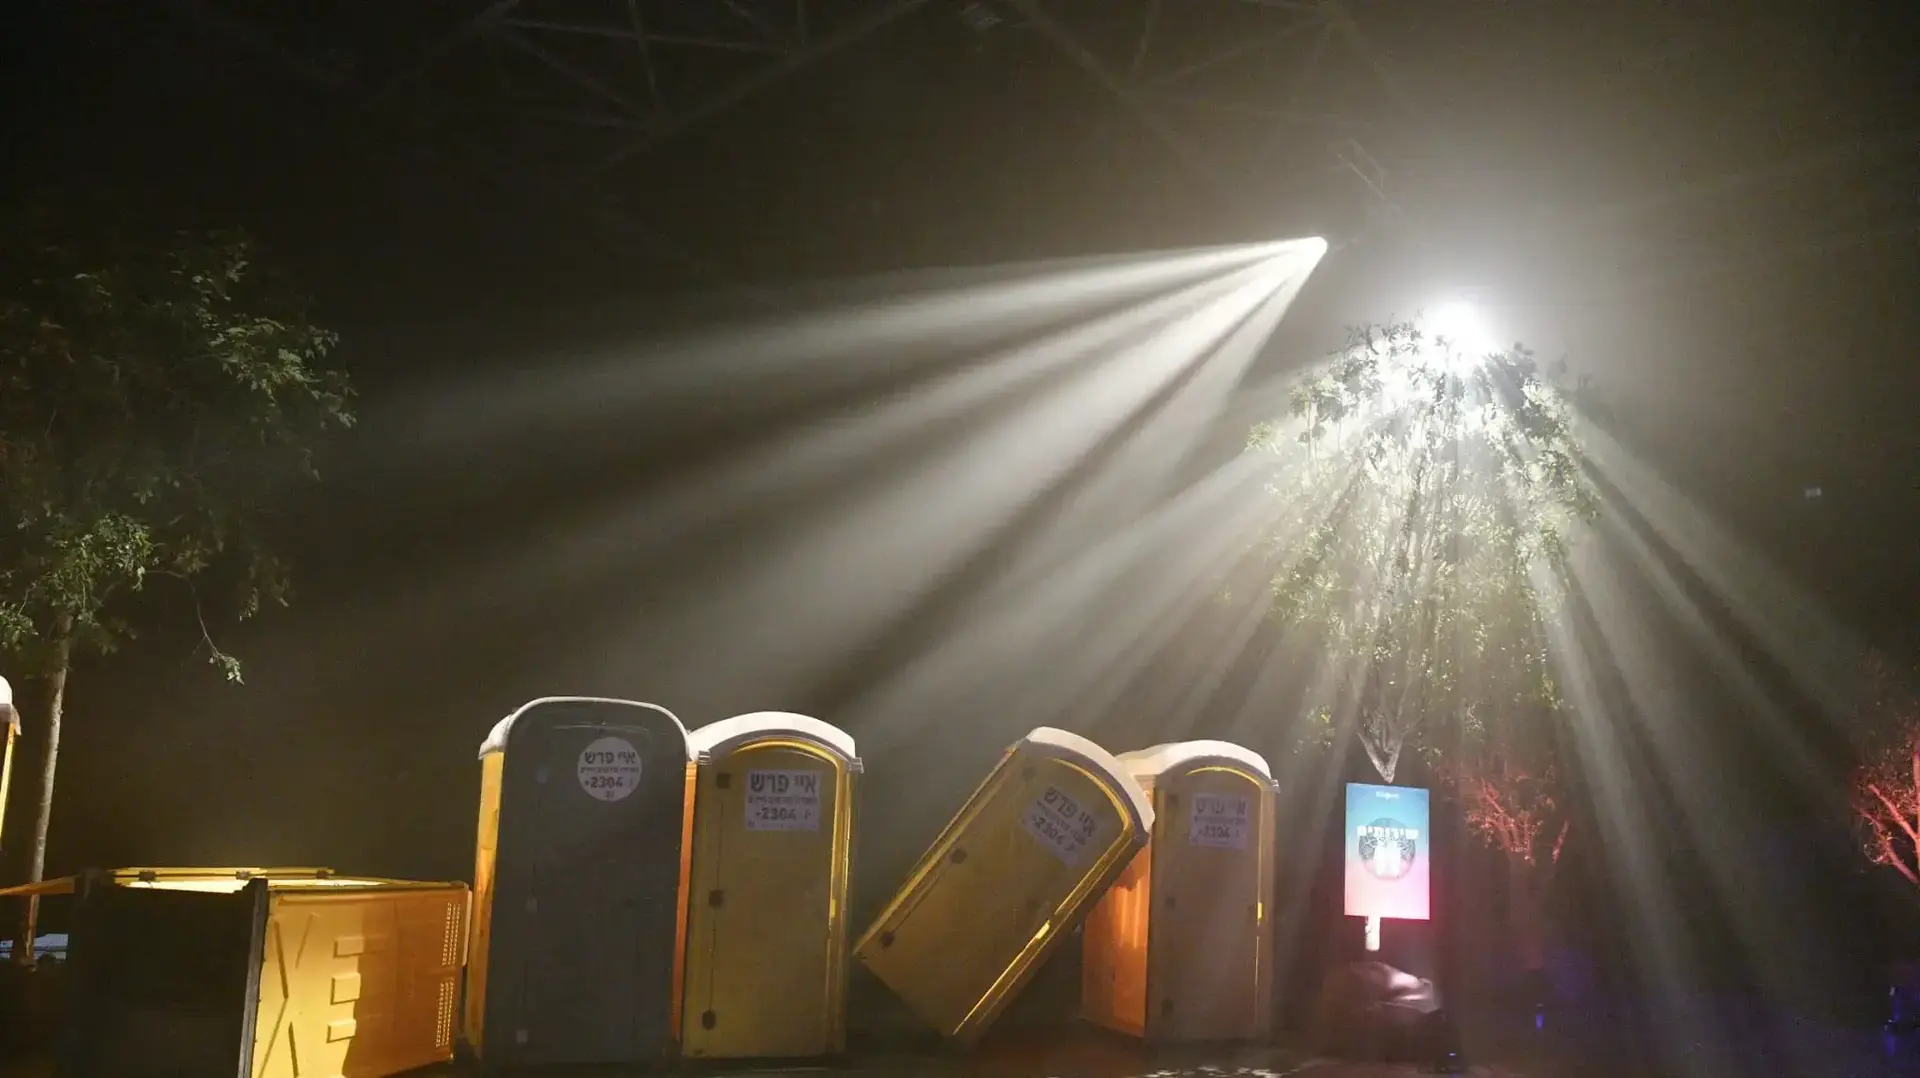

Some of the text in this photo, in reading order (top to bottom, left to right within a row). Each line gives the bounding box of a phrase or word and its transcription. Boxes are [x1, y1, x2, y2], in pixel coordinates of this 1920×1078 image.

[584, 750, 615, 765] פרש
[750, 773, 817, 794] איי פרש
[1357, 825, 1419, 840] שירותים
